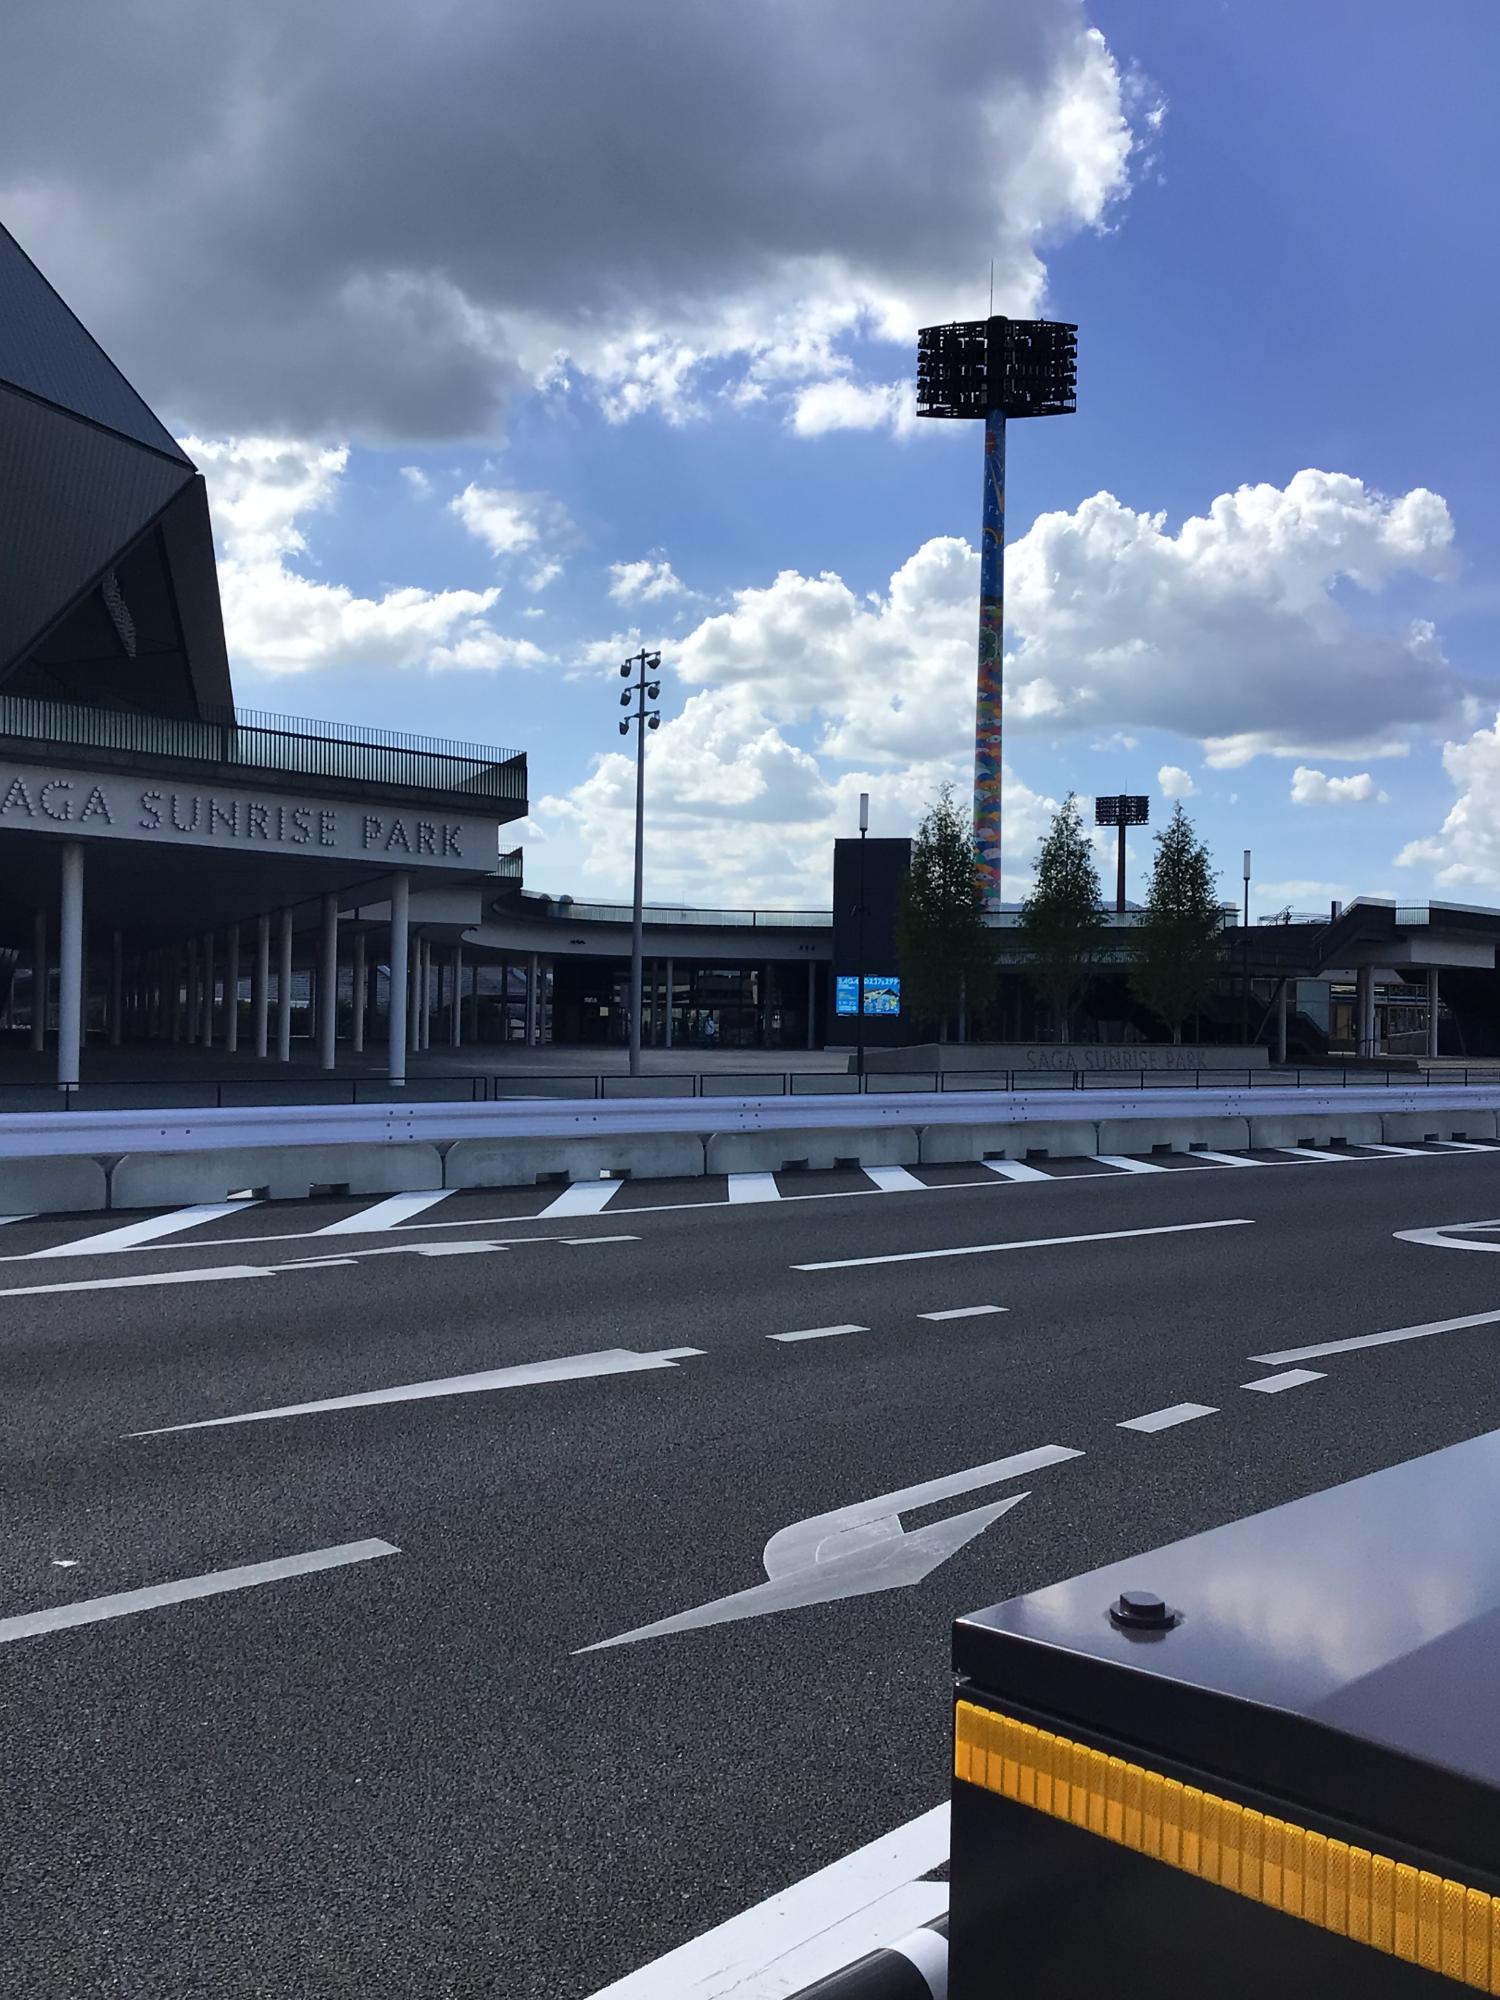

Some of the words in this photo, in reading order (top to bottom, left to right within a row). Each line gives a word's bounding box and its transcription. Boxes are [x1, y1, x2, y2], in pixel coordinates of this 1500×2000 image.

[139, 790, 338, 846] SUNRISE
[363, 815, 464, 857] PARK
[1027, 1050, 1077, 1070] SAGA
[1085, 1050, 1157, 1070] SUNRISE
[1166, 1052, 1208, 1070] PARK
